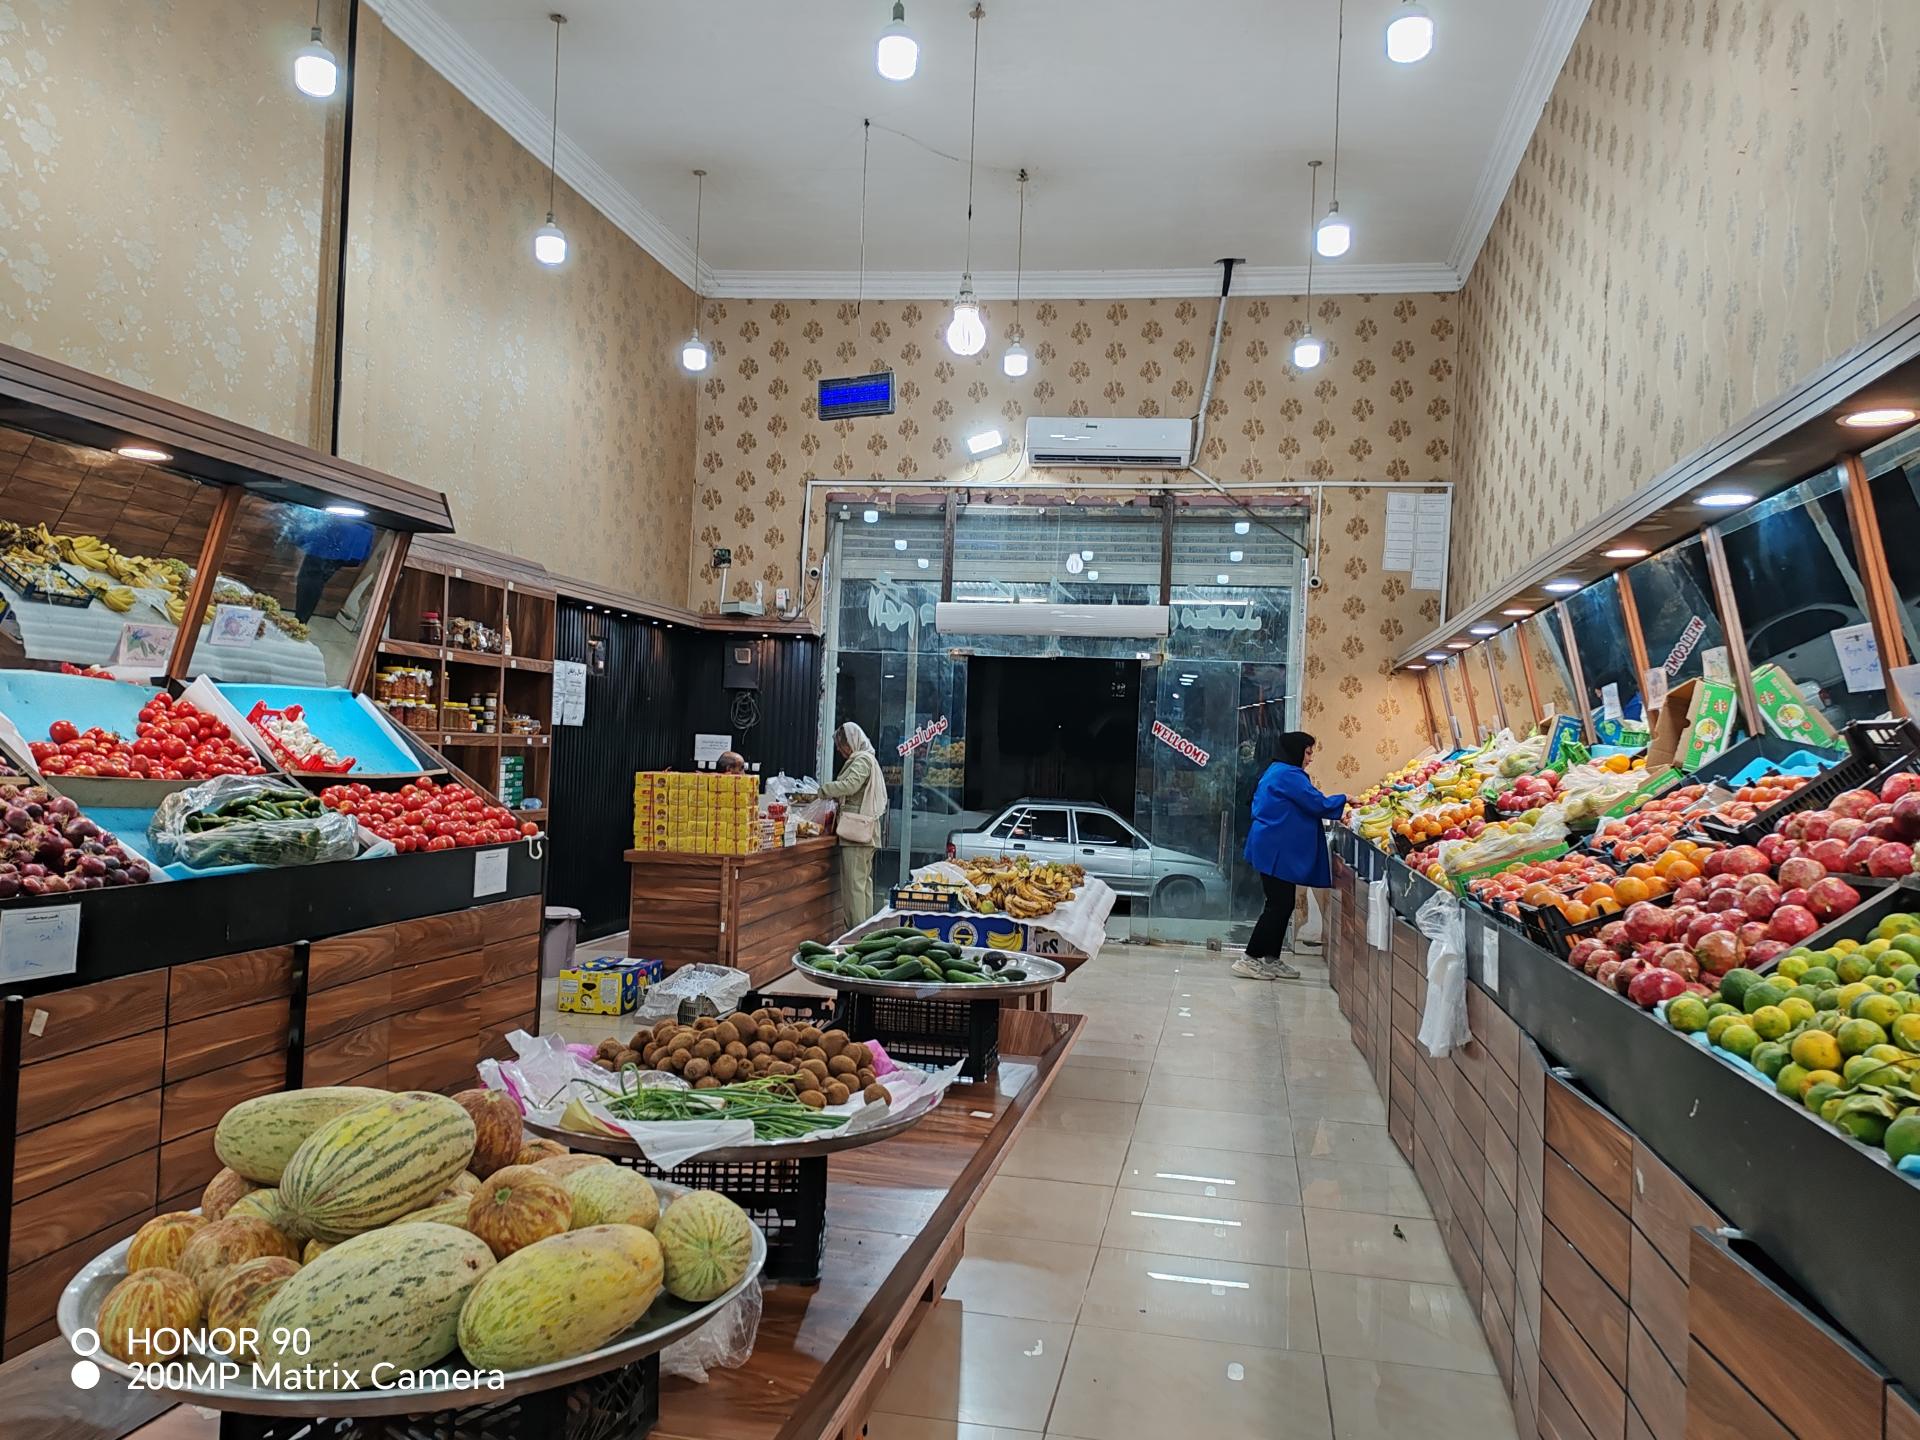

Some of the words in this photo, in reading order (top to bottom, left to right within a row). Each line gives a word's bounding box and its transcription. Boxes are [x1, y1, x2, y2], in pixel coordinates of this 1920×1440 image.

[896, 726, 924, 757] آمدید
[923, 714, 948, 742] خوش
[1152, 721, 1210, 766] WELLCOME
